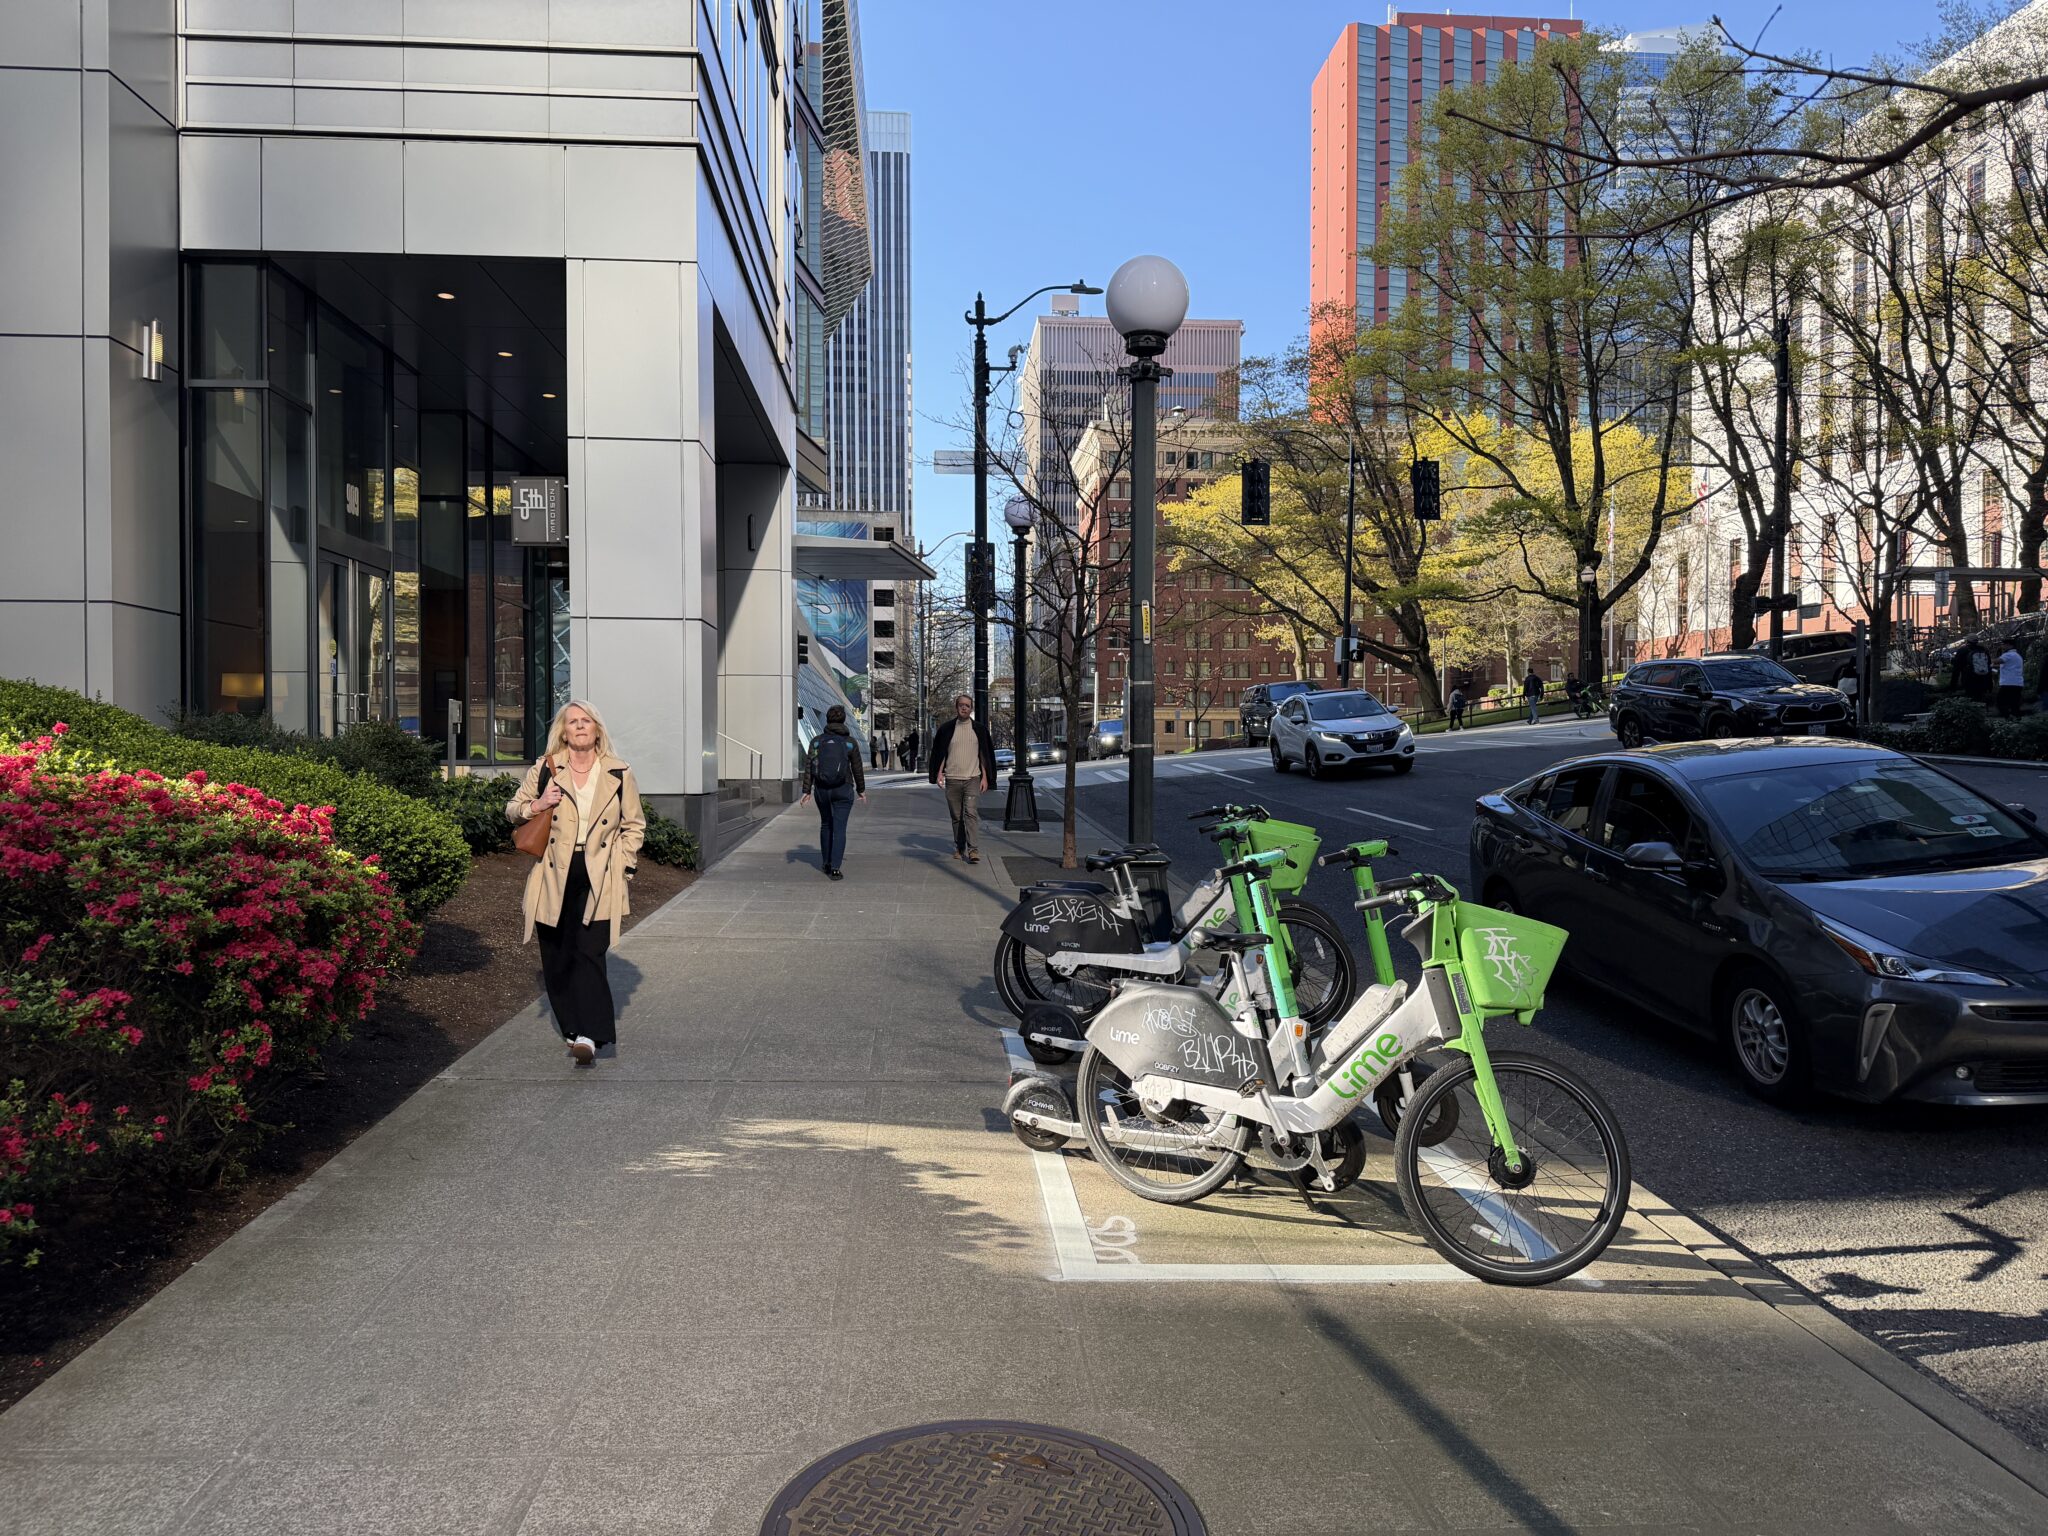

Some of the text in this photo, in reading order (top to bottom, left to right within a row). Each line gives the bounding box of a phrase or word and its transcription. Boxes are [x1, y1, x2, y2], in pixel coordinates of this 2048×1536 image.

[1024, 922, 1050, 933] Lime
[1110, 1027, 1140, 1045] Lime
[1327, 1033, 1403, 1099] Lime
